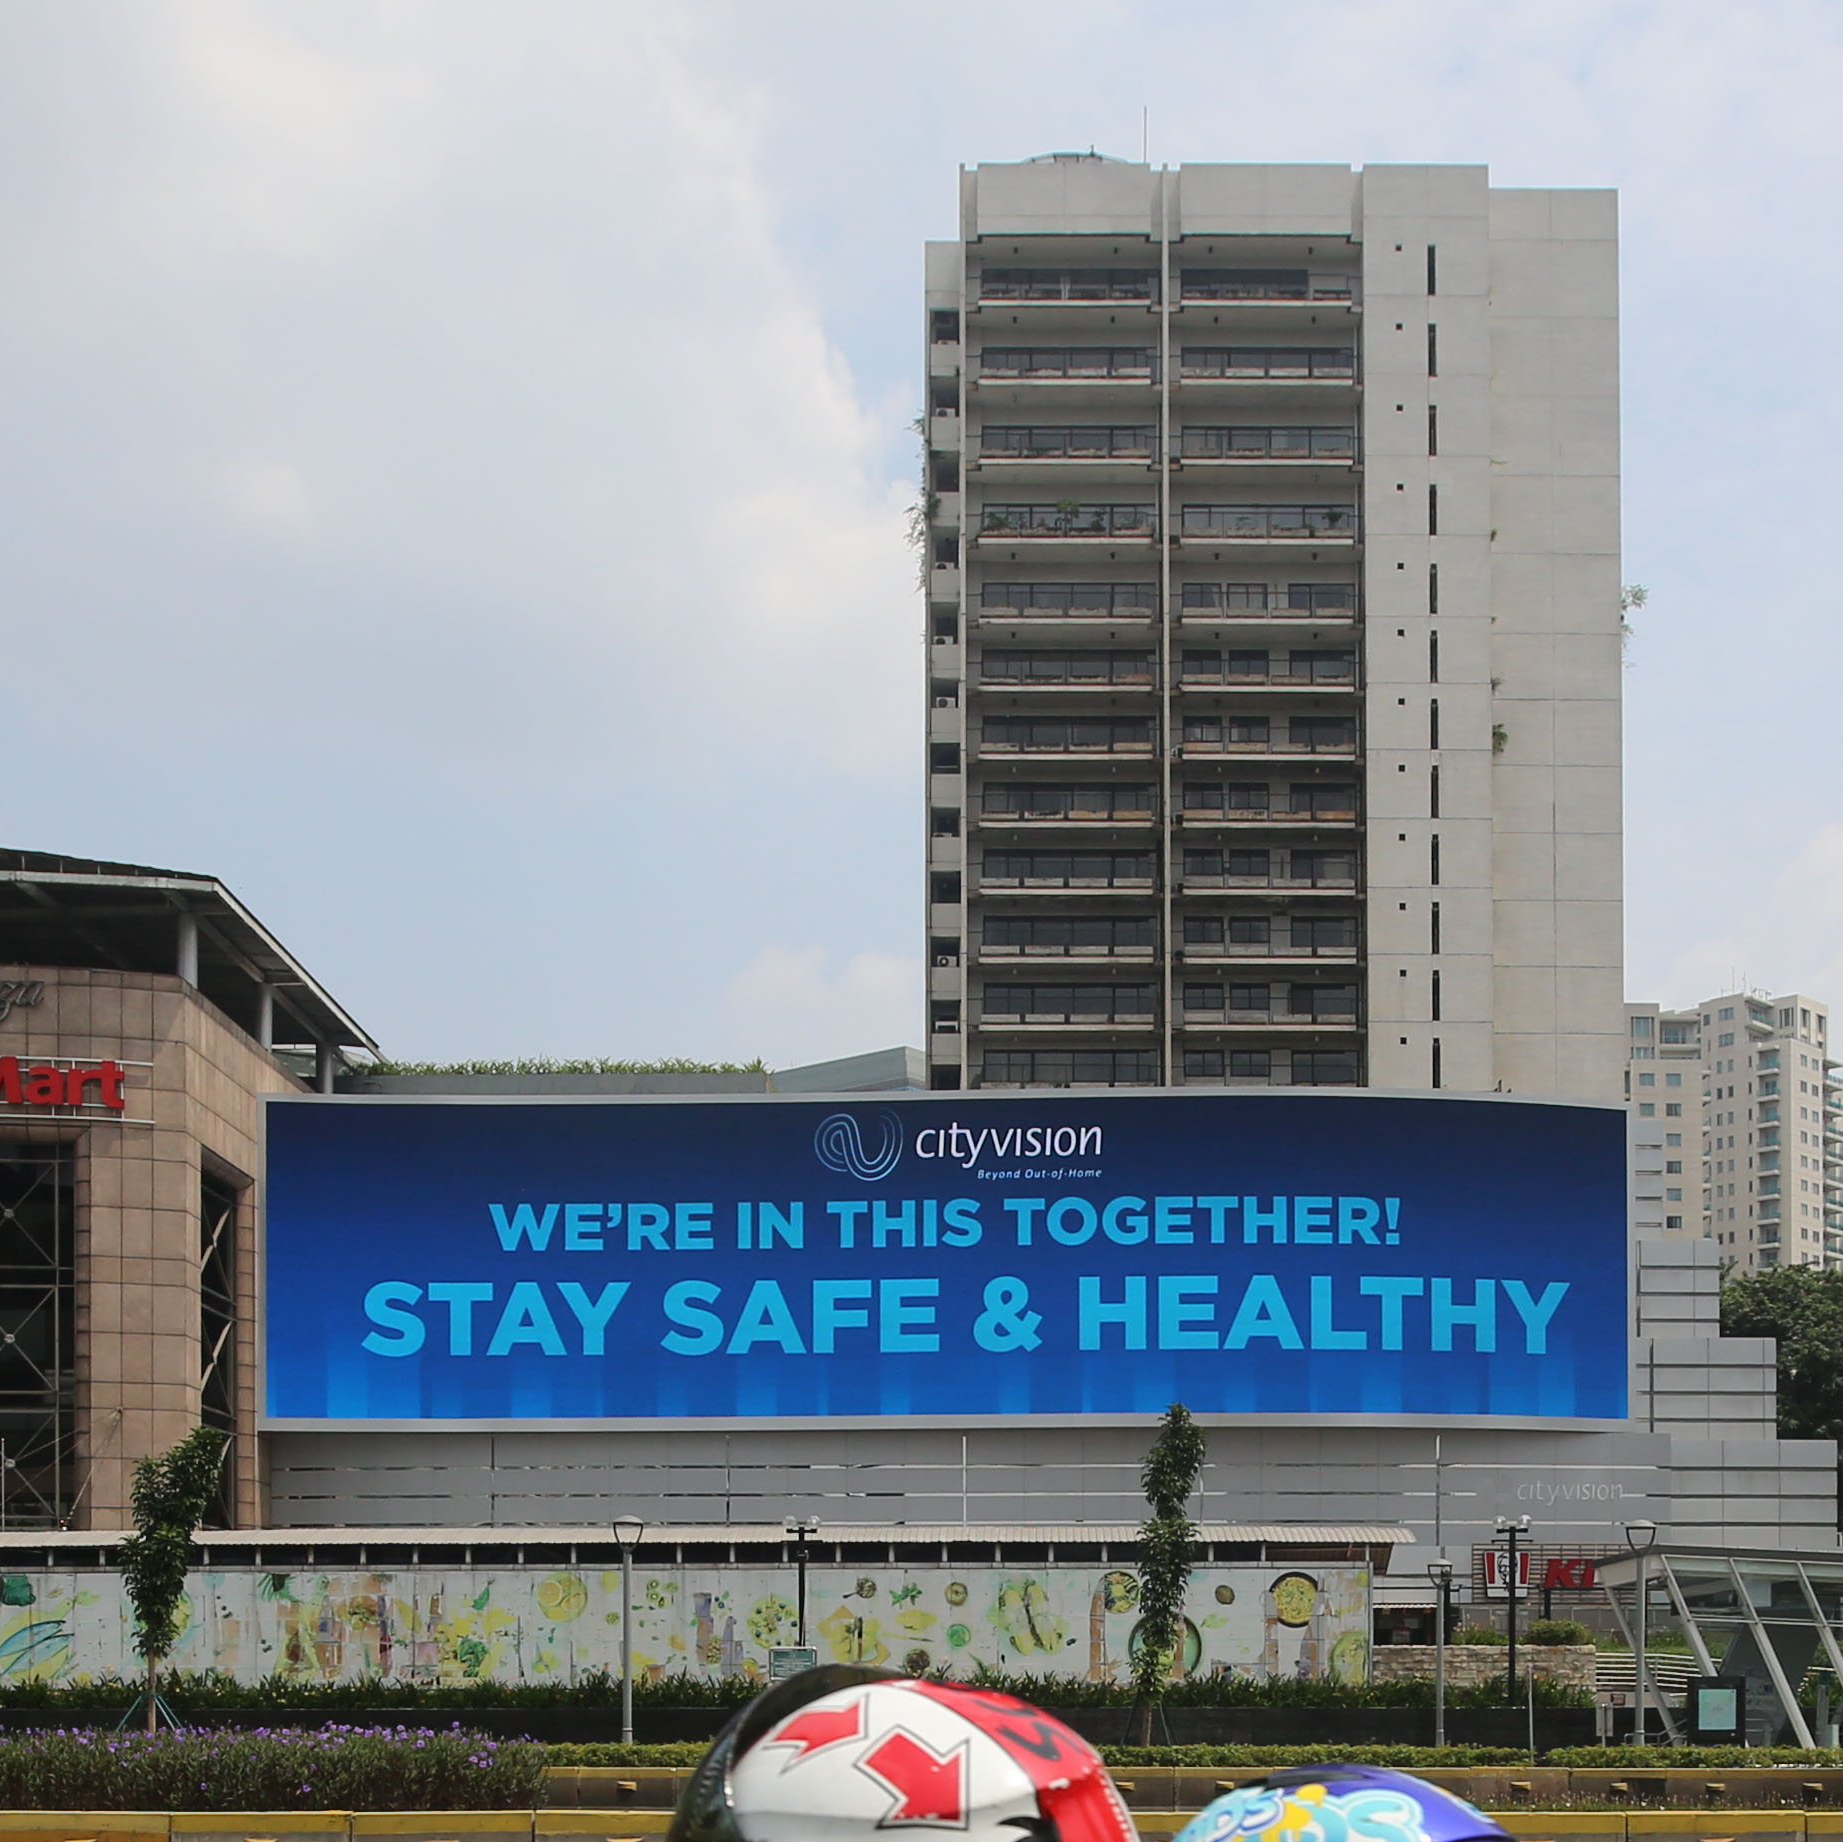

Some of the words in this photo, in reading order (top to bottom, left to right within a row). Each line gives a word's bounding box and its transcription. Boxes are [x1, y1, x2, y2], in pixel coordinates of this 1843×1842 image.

[916, 1122, 1102, 1169] cityvision
[977, 1169, 1021, 1180] Beyond
[1025, 1168, 1103, 1180] Out-of-Home
[487, 1202, 715, 1251] WE’RE
[737, 1201, 805, 1249] IN
[826, 1199, 983, 1248] THIS
[1004, 1195, 1401, 1246] TOGETHER!
[360, 1280, 631, 1357] STAY
[660, 1277, 941, 1355] SAFE
[973, 1275, 1044, 1353] &
[1078, 1274, 1570, 1355] HEALTHY
[1518, 1480, 1623, 1506] cityvision
